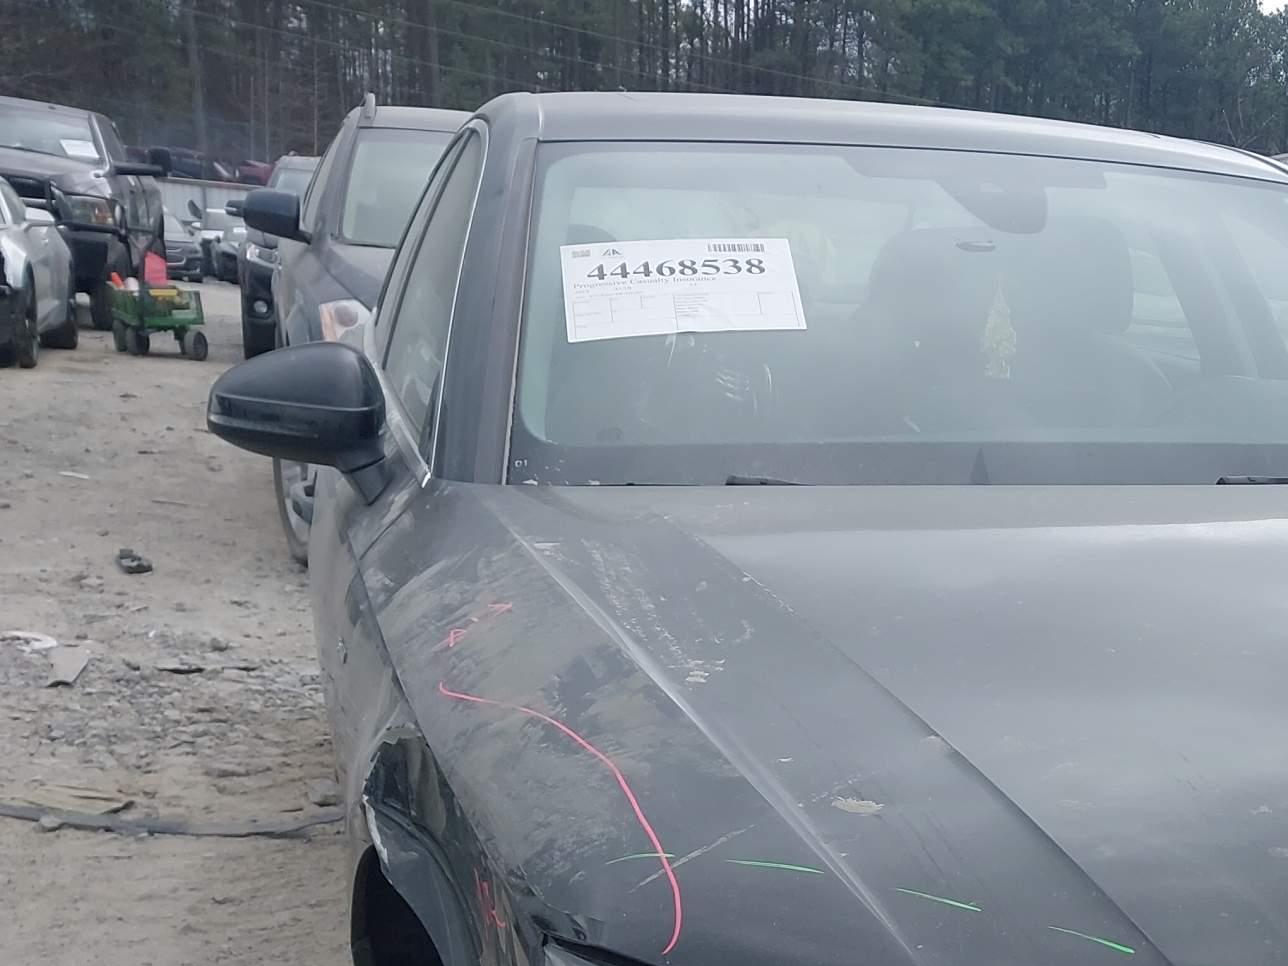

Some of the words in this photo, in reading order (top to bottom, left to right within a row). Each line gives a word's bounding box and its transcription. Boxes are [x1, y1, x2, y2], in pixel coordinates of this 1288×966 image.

[587, 258, 766, 280] 44468538
[573, 280, 627, 289] Progressive
[673, 275, 717, 284] Insurance
